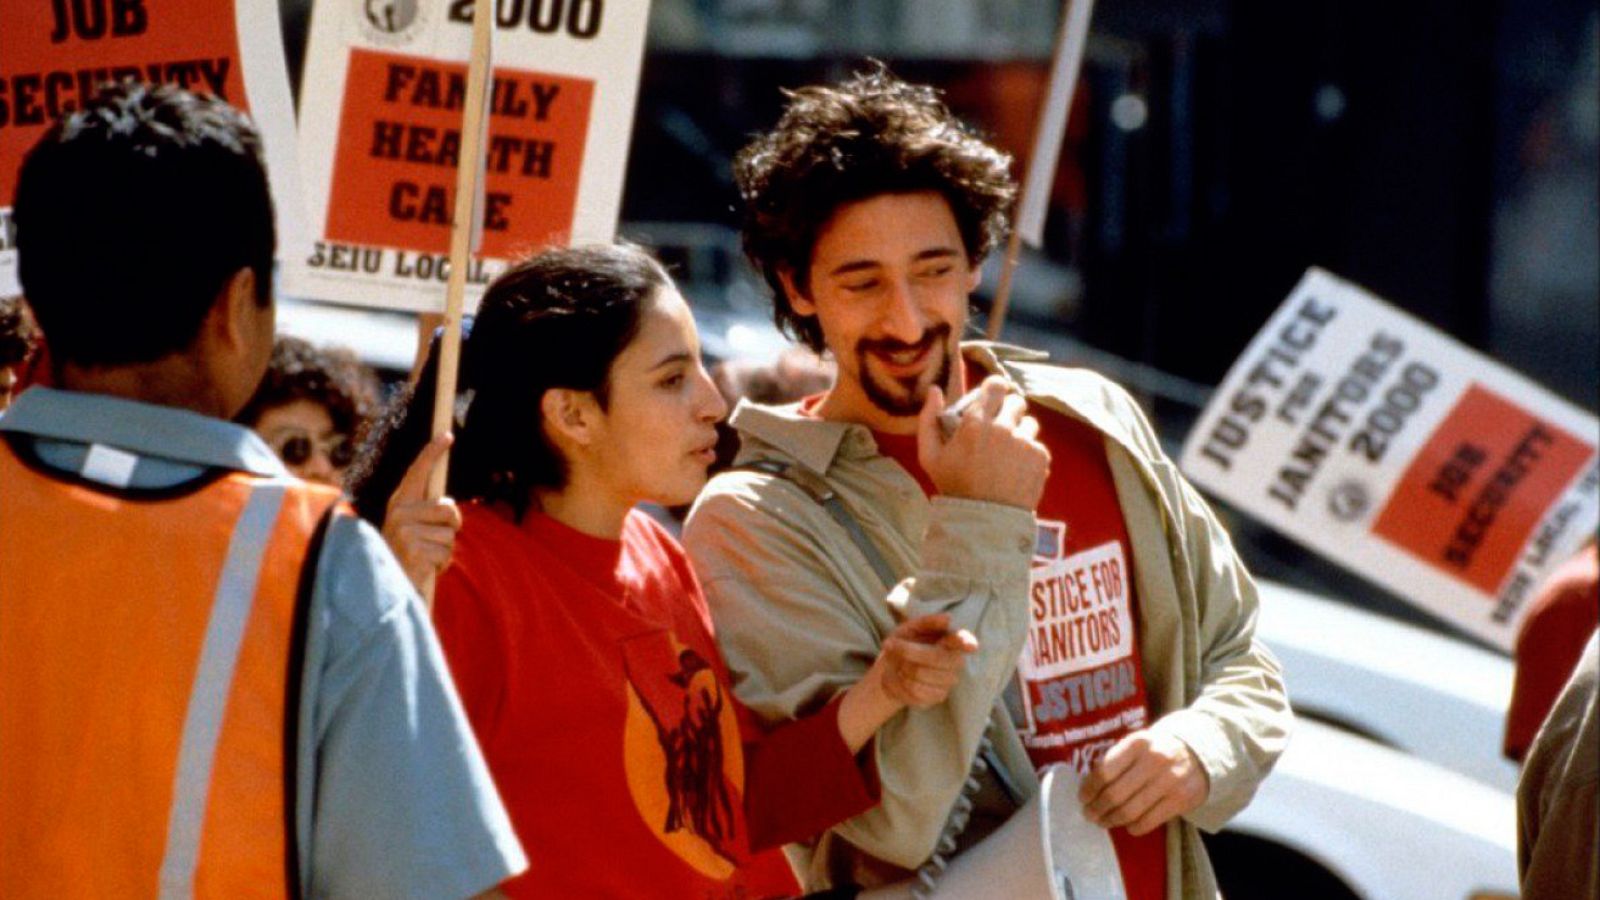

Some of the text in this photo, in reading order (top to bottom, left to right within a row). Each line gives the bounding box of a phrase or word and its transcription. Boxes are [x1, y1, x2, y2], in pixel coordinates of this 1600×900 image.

[369, 120, 555, 178] HEATH
[388, 182, 512, 231] CAE
[308, 242, 382, 273] SEIU
[1200, 297, 1338, 471] JUSTICE
[1349, 361, 1440, 464] 2000
[1267, 330, 1405, 510] JANITORS
[1032, 557, 1122, 622] STICE FOR
